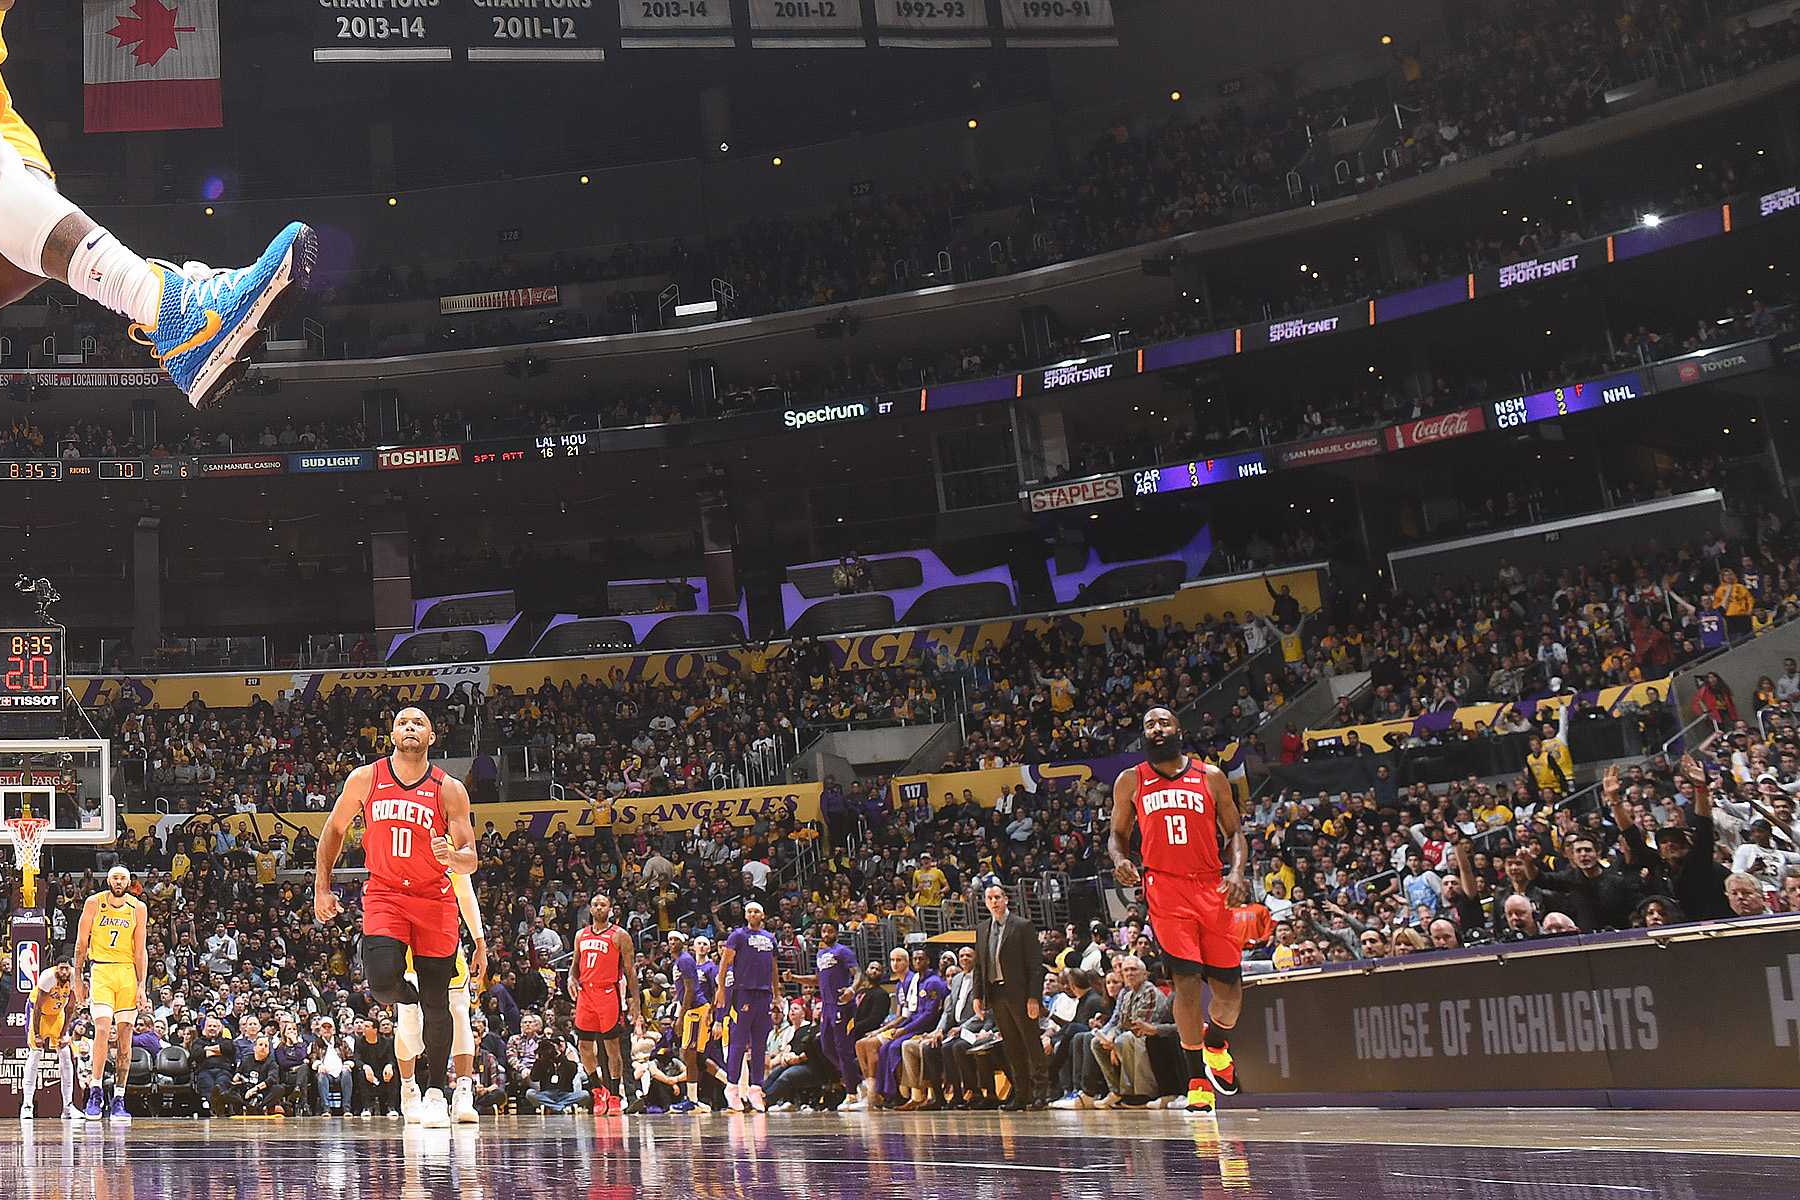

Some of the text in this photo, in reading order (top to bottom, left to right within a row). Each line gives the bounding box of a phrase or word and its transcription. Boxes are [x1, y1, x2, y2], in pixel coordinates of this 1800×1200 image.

[641, 1, 708, 18] 2013-14
[774, 1, 837, 18] 2011-12
[896, 1, 966, 18] 1992-93
[1022, 1, 1091, 18] 1990-91
[336, 16, 427, 40] 2013-14
[492, 16, 578, 40] 2011-12
[1499, 253, 1580, 289] SPORTSNET
[1269, 317, 1340, 343] SPORTSNET
[1701, 354, 1747, 374] TOYOTA
[72, 373, 108, 387] LOCATION
[109, 373, 120, 387] TO
[120, 373, 160, 387] 69050
[1043, 363, 1114, 390] SPORTSNET
[1554, 388, 1565, 402] 3
[1602, 384, 1636, 404] NHL
[783, 401, 866, 429] Spectrum
[1494, 396, 1526, 416] NSH
[1557, 401, 1568, 416] 2
[1411, 408, 1470, 444] Coca-Cola
[1497, 409, 1528, 429] CGY
[535, 433, 587, 449] LAL HOU
[1307, 437, 1378, 458] MANUEL CASINO
[301, 455, 361, 469] BUD LIGHT
[379, 447, 460, 467] TOSHIBA
[474, 445, 580, 464] 3PT ATT 16 21
[10, 463, 44, 478] 8:35
[114, 463, 135, 478] 70
[180, 466, 188, 478] 6
[208, 460, 281, 472] SAN MANUEL CASINO
[1238, 461, 1268, 479] NHL
[1134, 468, 1161, 484] CAR
[1032, 478, 1121, 511] STAPLES
[1135, 481, 1158, 497] ARI
[11, 635, 53, 655] 8:35
[5, 656, 48, 690] 20
[247, 678, 259, 686] 217
[13, 695, 60, 706] TISSOT
[904, 784, 921, 799] 117
[645, 793, 800, 822] ANGELES
[1142, 788, 1205, 816] ROCKETS
[371, 798, 435, 831] ROCKETS
[1164, 814, 1188, 845] 13
[390, 825, 413, 858] 10
[98, 914, 131, 930] LAKERS
[109, 930, 119, 949] 7
[579, 938, 610, 954] ROCKETS
[586, 952, 598, 969] 17
[1352, 984, 1659, 1061] HOUSE OF HIGHLIGHTS
